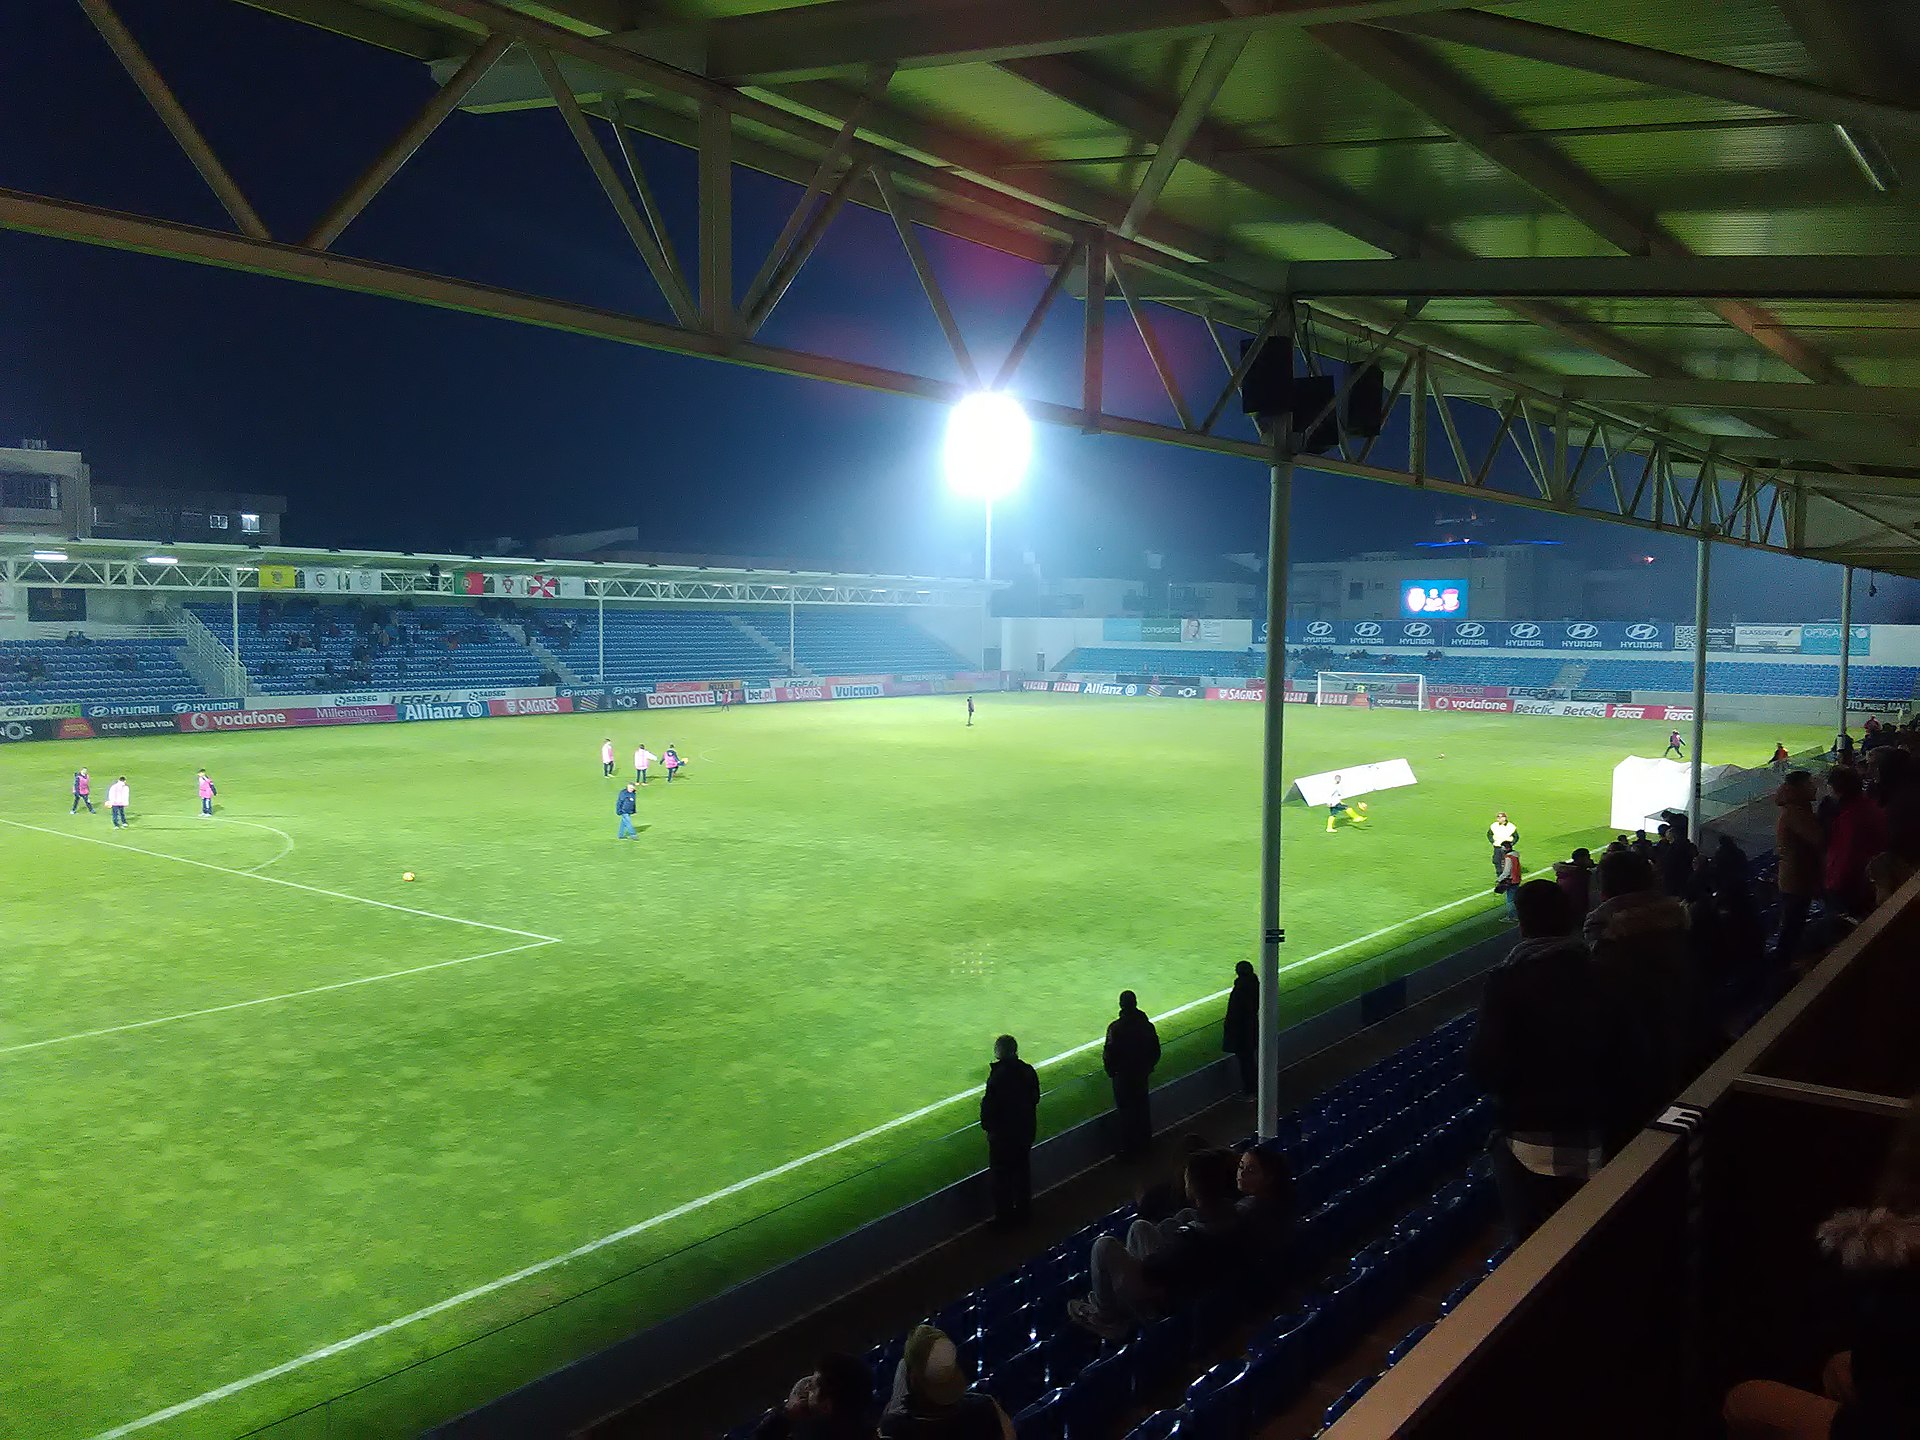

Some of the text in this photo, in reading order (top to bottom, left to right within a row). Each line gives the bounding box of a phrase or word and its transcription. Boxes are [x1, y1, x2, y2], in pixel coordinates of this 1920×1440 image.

[1303, 636, 1336, 644] HYUNDAI
[1350, 637, 1384, 645] HYUNDAI
[1399, 638, 1435, 646] HYUNDAI
[1451, 638, 1489, 647] HYUNDAI
[1505, 639, 1544, 648] HYUNDAI
[1561, 640, 1602, 649] HYUNDAI
[1620, 640, 1663, 650] HYUNDAI
[835, 685, 880, 698] Vulcano
[1083, 682, 1122, 695] Allianz
[1178, 688, 1197, 698] NOS
[648, 692, 715, 706] CONTINENTE
[1228, 688, 1262, 701] SAGRES
[193, 702, 239, 711] HYUNDAI
[518, 698, 560, 715] SAGRES
[616, 695, 638, 708] NOS
[1451, 699, 1507, 711] vodafone
[6, 705, 78, 717] CARLOS DIAS
[110, 706, 160, 715] HYUNDAI
[315, 707, 378, 719] Millennium
[405, 703, 464, 720] Allianz
[1515, 704, 1555, 714] Betclic
[1563, 706, 1605, 717] Betclic
[213, 711, 287, 726] vodafone
